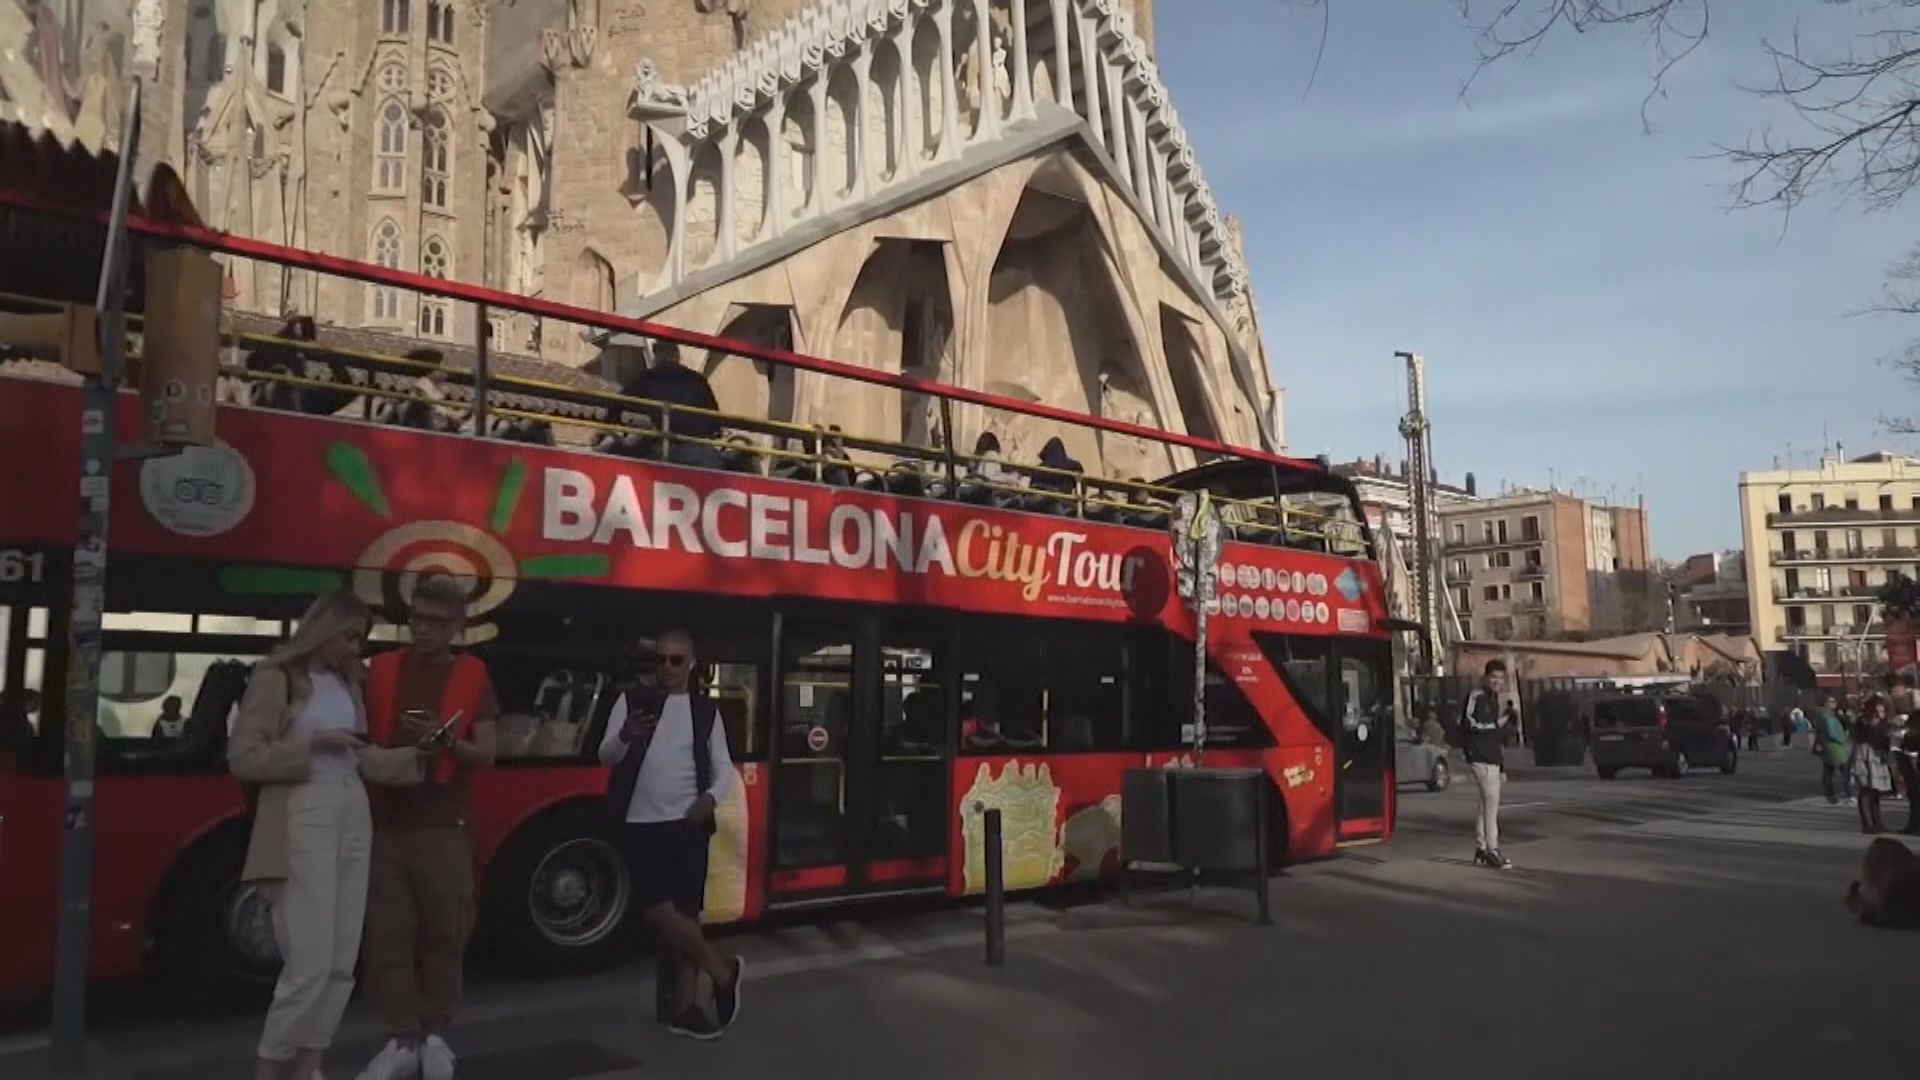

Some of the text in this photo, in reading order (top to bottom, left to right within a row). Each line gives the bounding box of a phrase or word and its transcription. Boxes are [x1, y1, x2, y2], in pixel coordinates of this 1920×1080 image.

[543, 467, 1144, 600] BARCELONA City Tour
